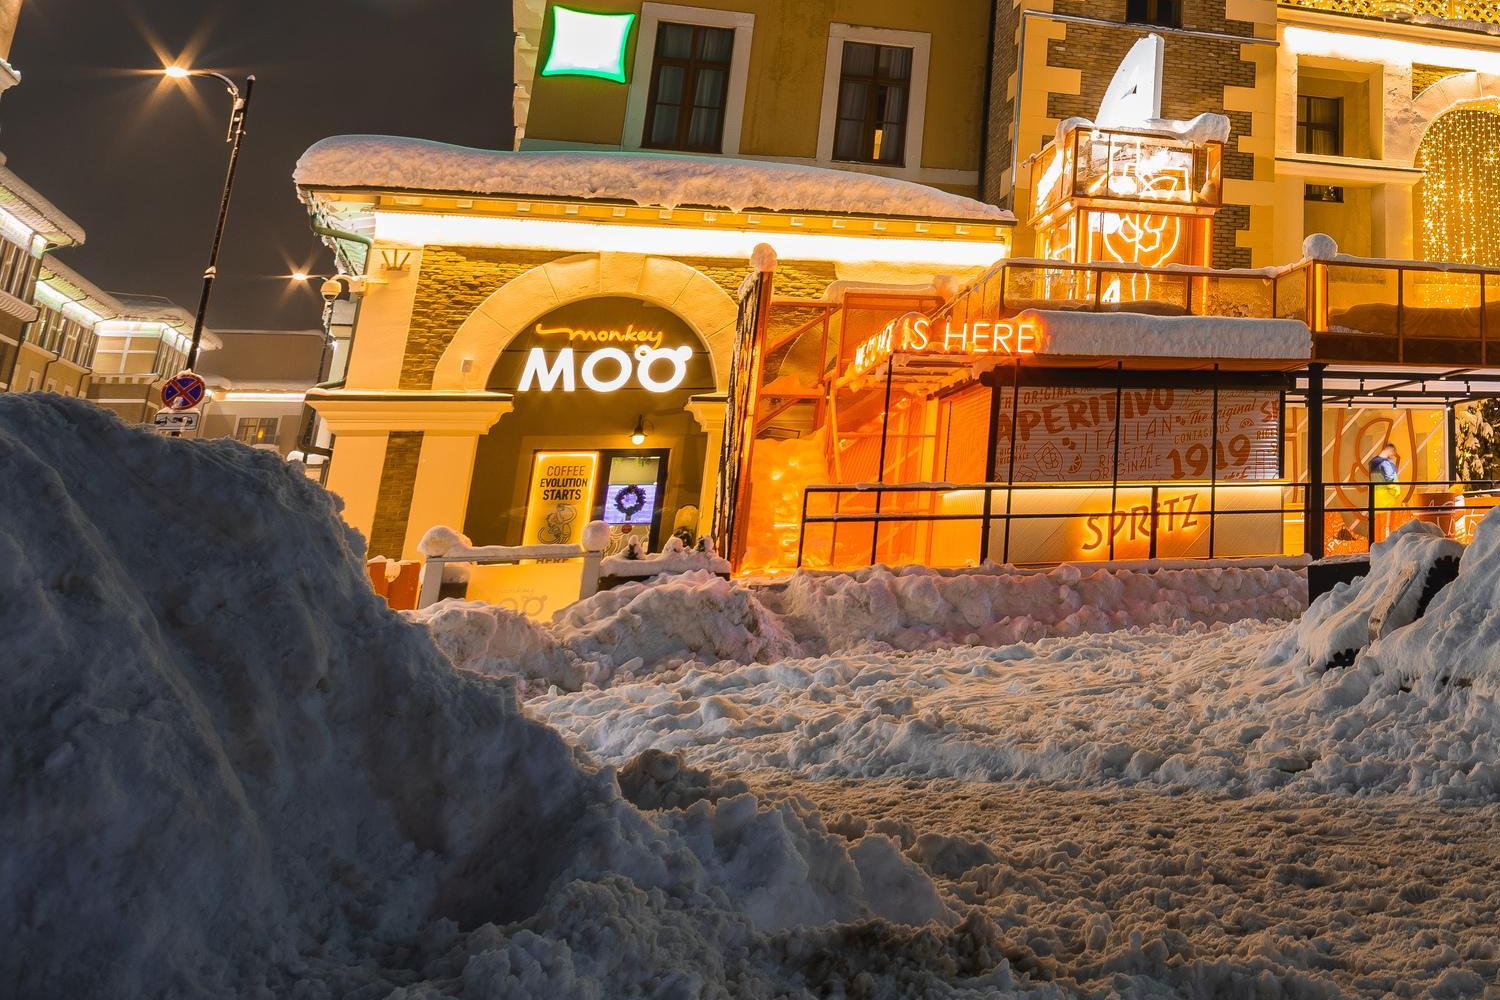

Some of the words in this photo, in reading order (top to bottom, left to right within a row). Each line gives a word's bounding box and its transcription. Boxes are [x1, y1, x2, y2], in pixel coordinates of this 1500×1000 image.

[535, 322, 663, 350] monkey
[943, 321, 1035, 354] HERE
[516, 344, 694, 393] MOO
[997, 388, 1175, 444] APERITIVO
[1211, 398, 1257, 424] riginal
[1084, 414, 1172, 454] ITALIAN
[1174, 423, 1231, 445] CONTAGIUS
[546, 465, 586, 476] COFFEE
[1165, 433, 1251, 480] 1919
[540, 478, 588, 488] EVOLUTION
[542, 488, 582, 500] STARTS
